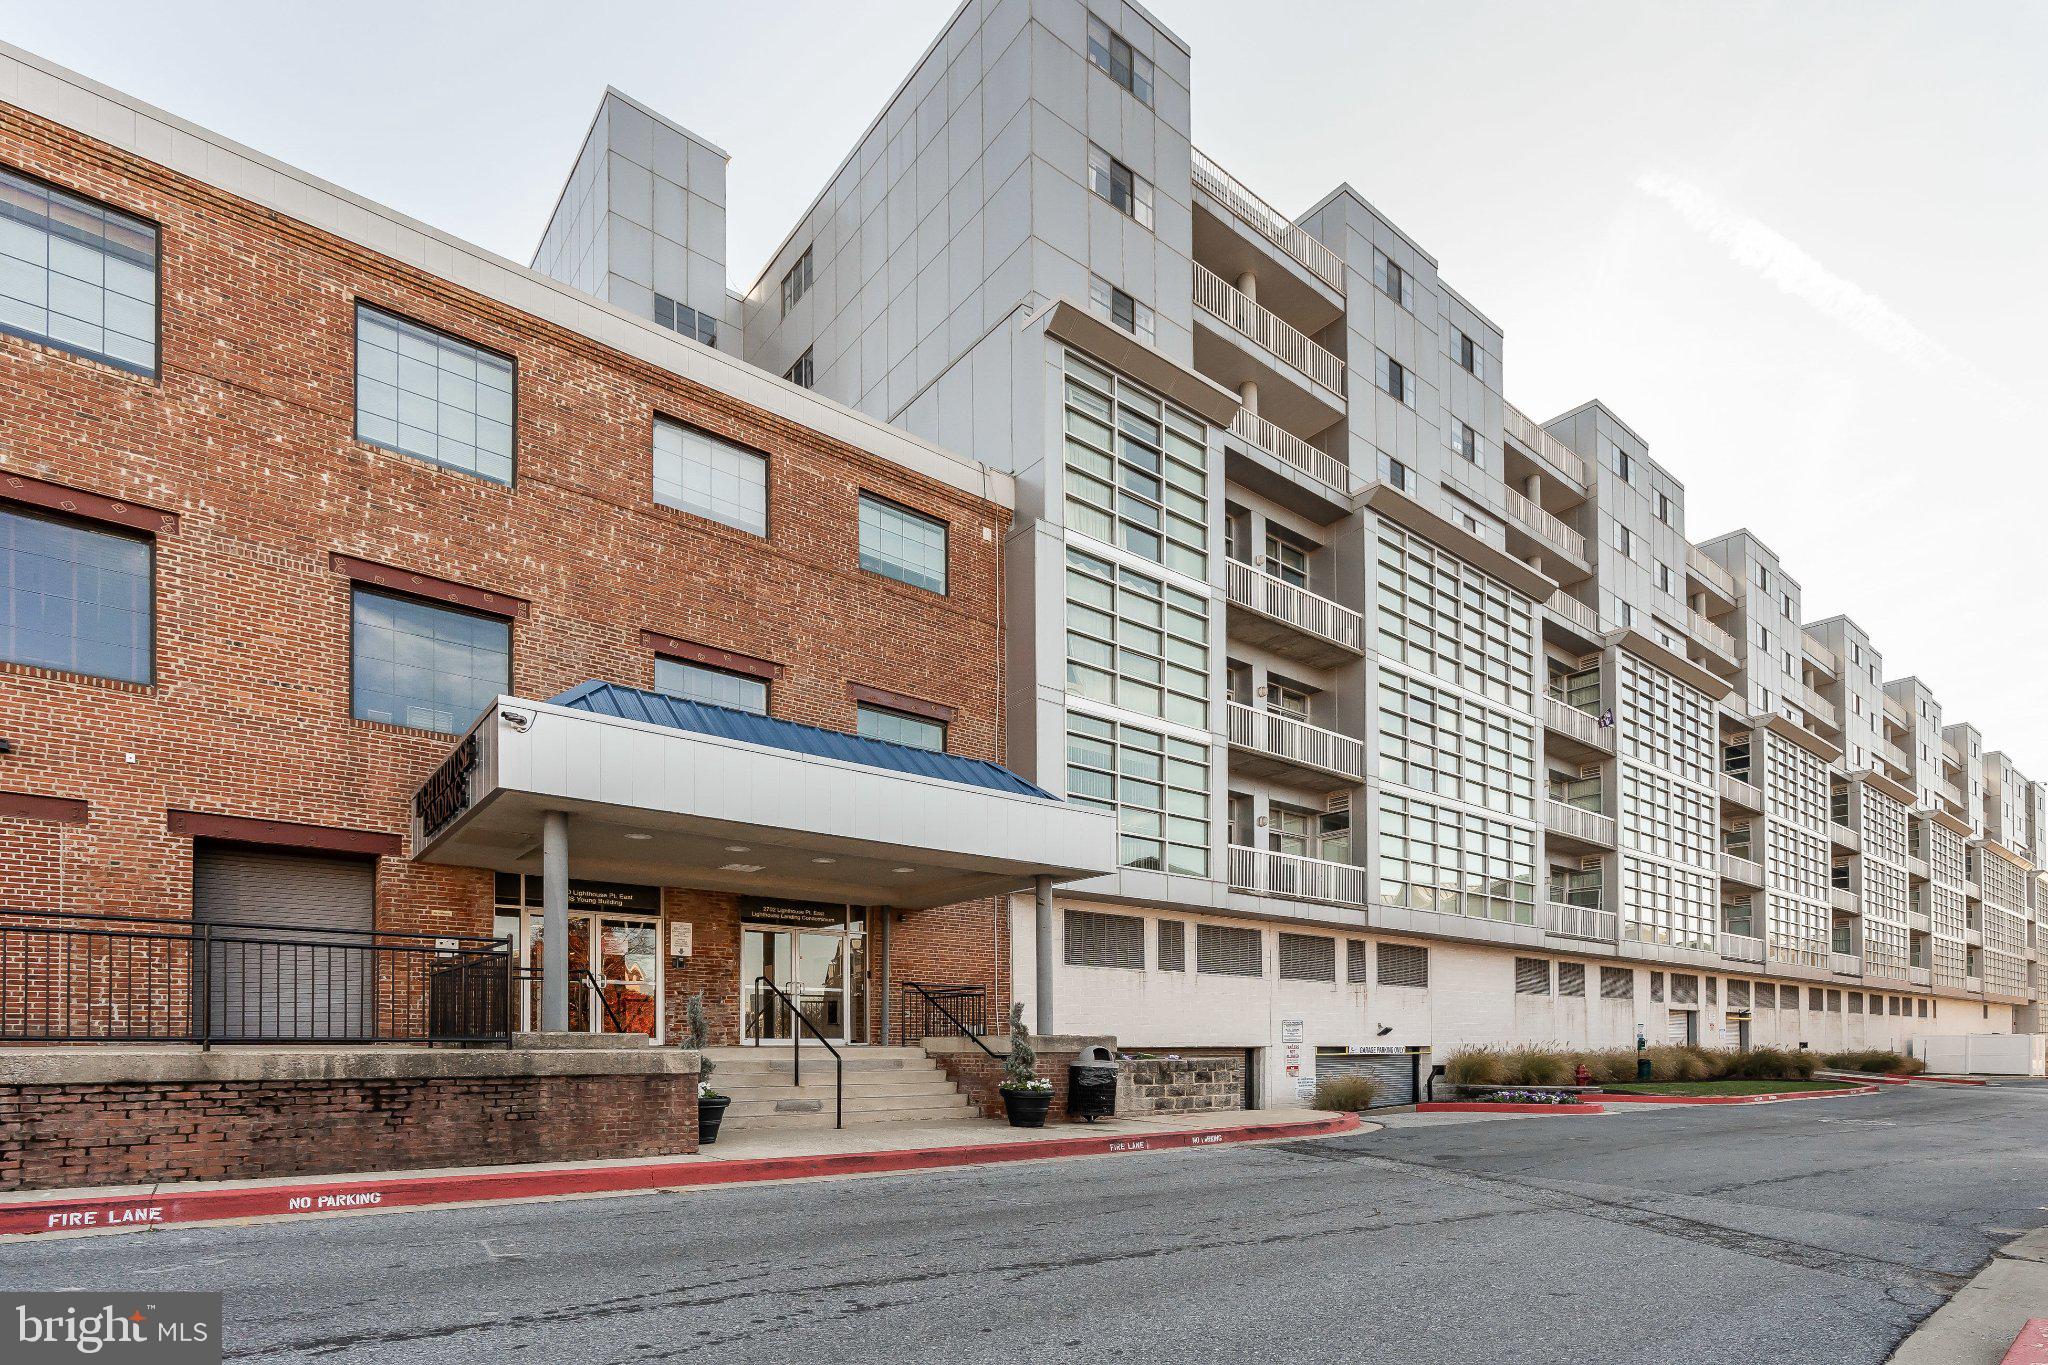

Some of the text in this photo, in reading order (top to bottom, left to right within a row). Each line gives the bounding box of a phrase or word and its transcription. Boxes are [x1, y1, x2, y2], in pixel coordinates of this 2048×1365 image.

[576, 896, 597, 905] Young
[598, 898, 623, 907] Building
[1109, 1141, 1145, 1152] FIRE LANE
[289, 1192, 382, 1210] NO PARKING
[48, 1207, 164, 1228] FIRE LANE
